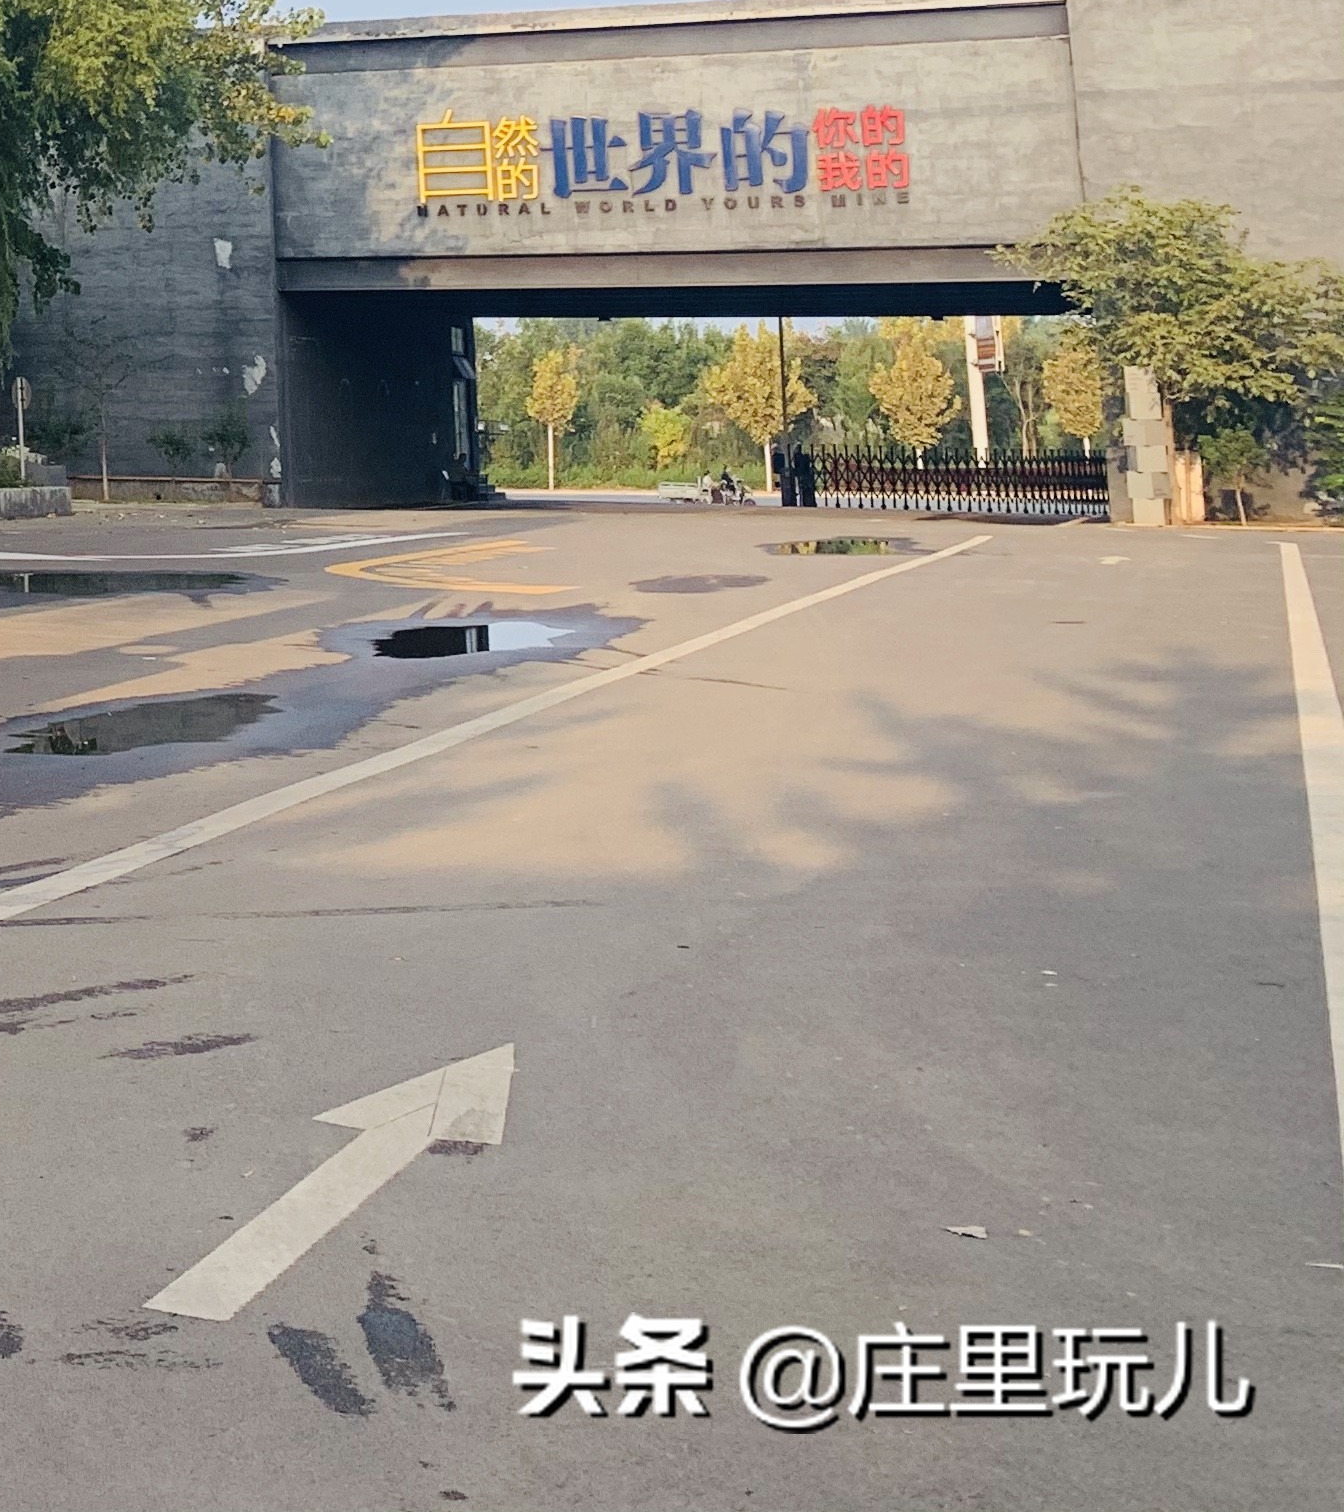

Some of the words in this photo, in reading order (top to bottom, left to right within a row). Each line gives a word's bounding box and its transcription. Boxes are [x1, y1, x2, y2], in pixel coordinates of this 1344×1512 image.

[540, 108, 809, 198] 世界的
[417, 201, 552, 217] NATURAL
[574, 199, 678, 214] WORLD
[701, 194, 806, 211] YOURS
[831, 192, 910, 208] MINE
